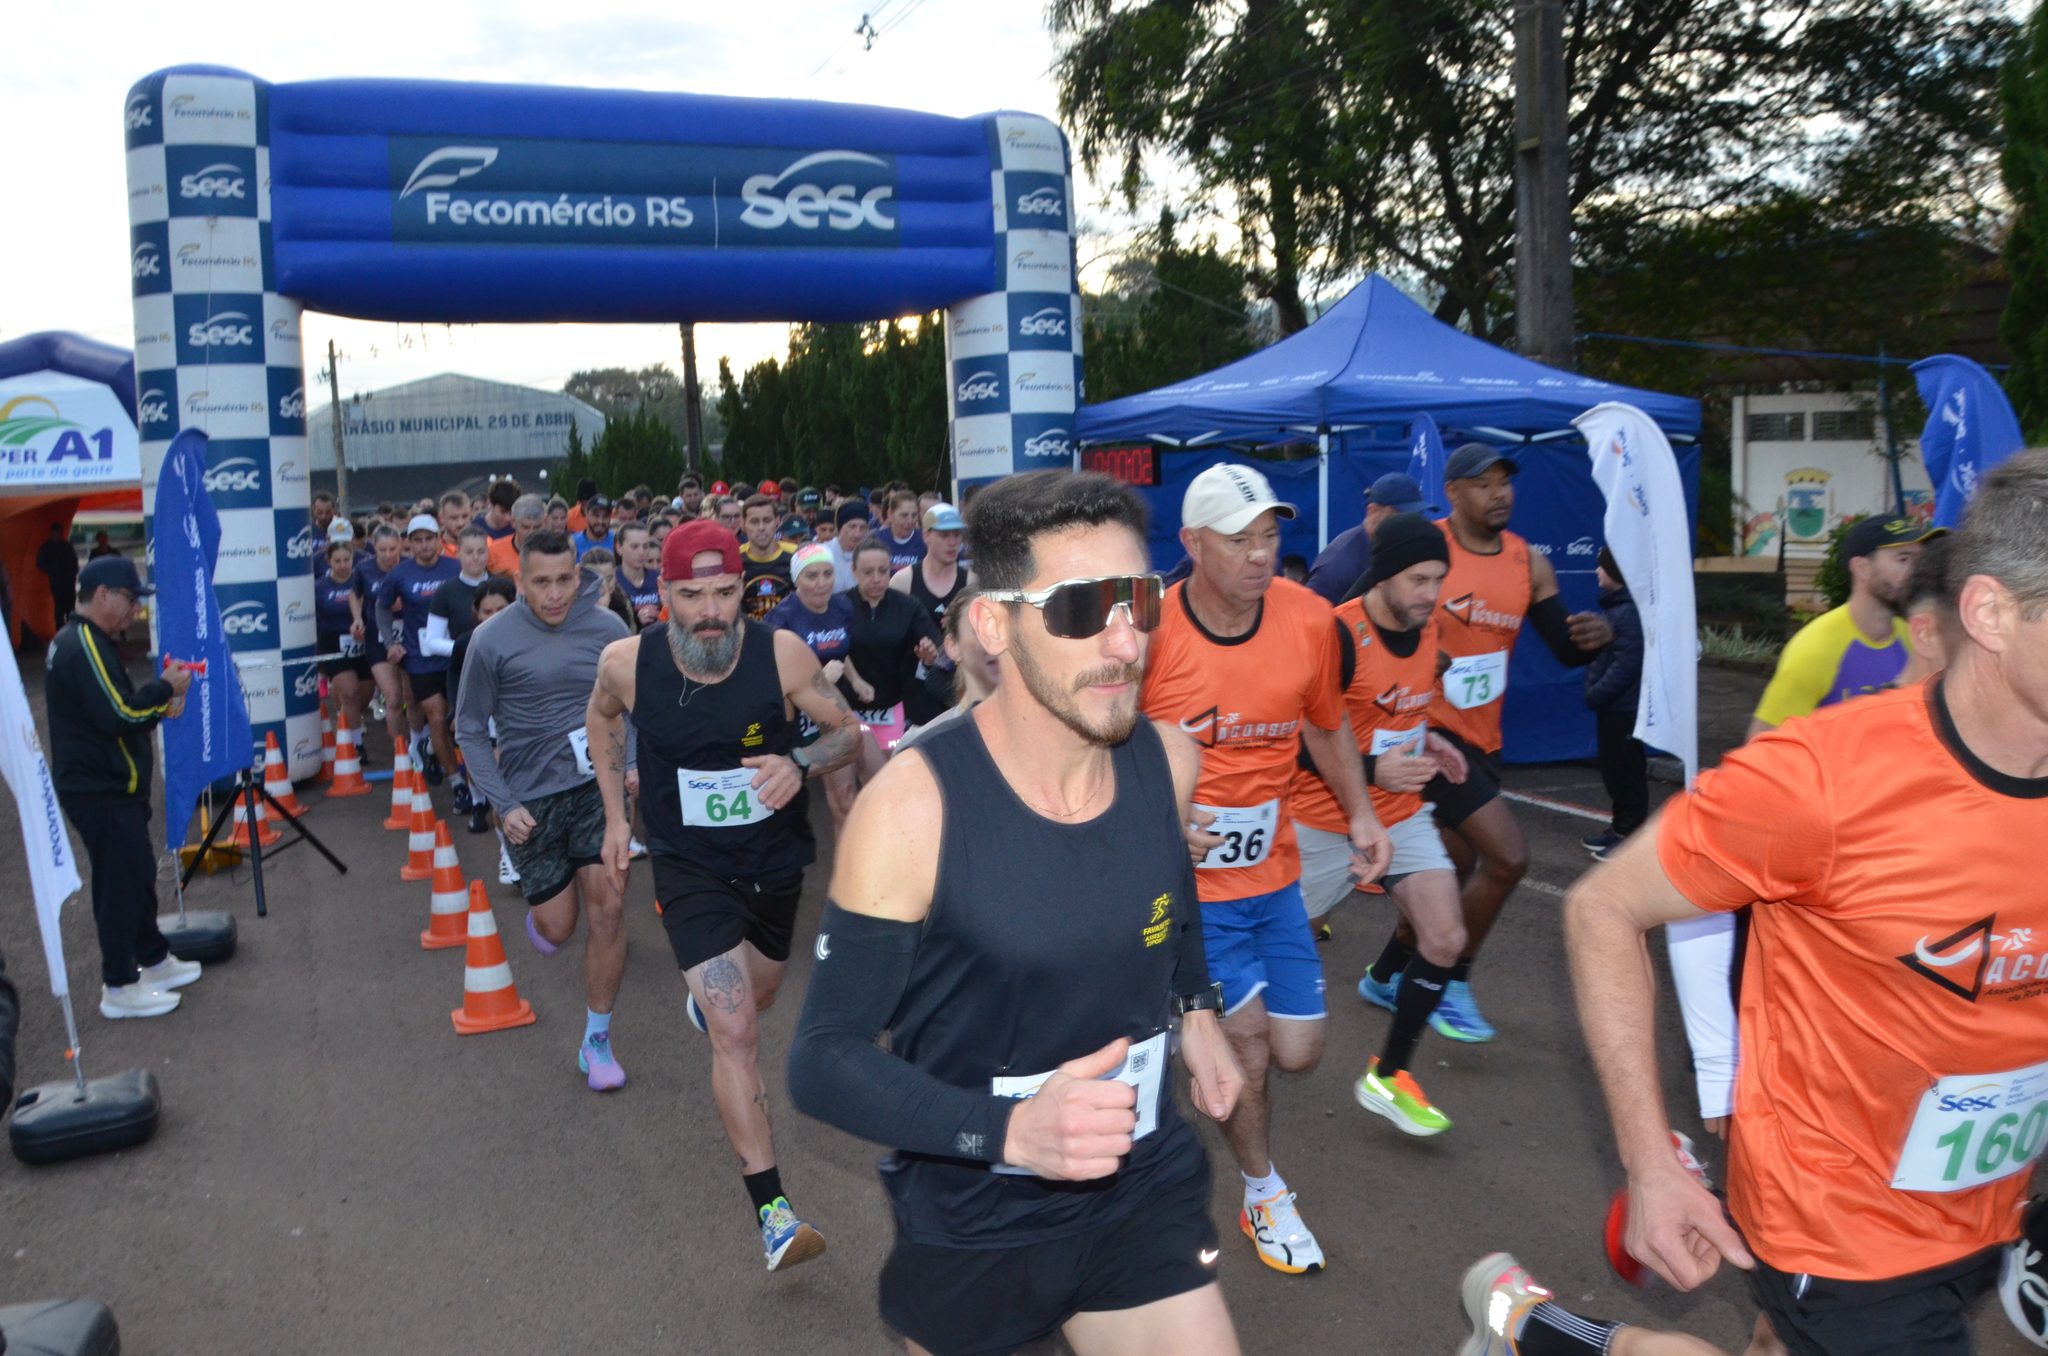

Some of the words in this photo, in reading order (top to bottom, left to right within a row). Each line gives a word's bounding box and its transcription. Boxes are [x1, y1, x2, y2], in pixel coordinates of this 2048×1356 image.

[180, 174, 245, 199] Sesc
[426, 194, 636, 226] Fecomércio
[647, 197, 694, 227] RS
[741, 175, 895, 230] Sesc
[188, 322, 252, 347] Sesc
[1019, 315, 1066, 336] Sesc
[958, 381, 999, 402] Sesc
[400, 417, 482, 433] MUNICIPAL
[512, 413, 529, 427] DE
[46, 427, 113, 461] A1
[1024, 438, 1070, 457] Sesc
[223, 612, 268, 634] esc
[1462, 673, 1490, 704] 73
[688, 780, 718, 790] Sesc
[706, 790, 752, 822] 64
[1938, 1094, 2000, 1112] Sesc
[1936, 1100, 2048, 1181] 160
